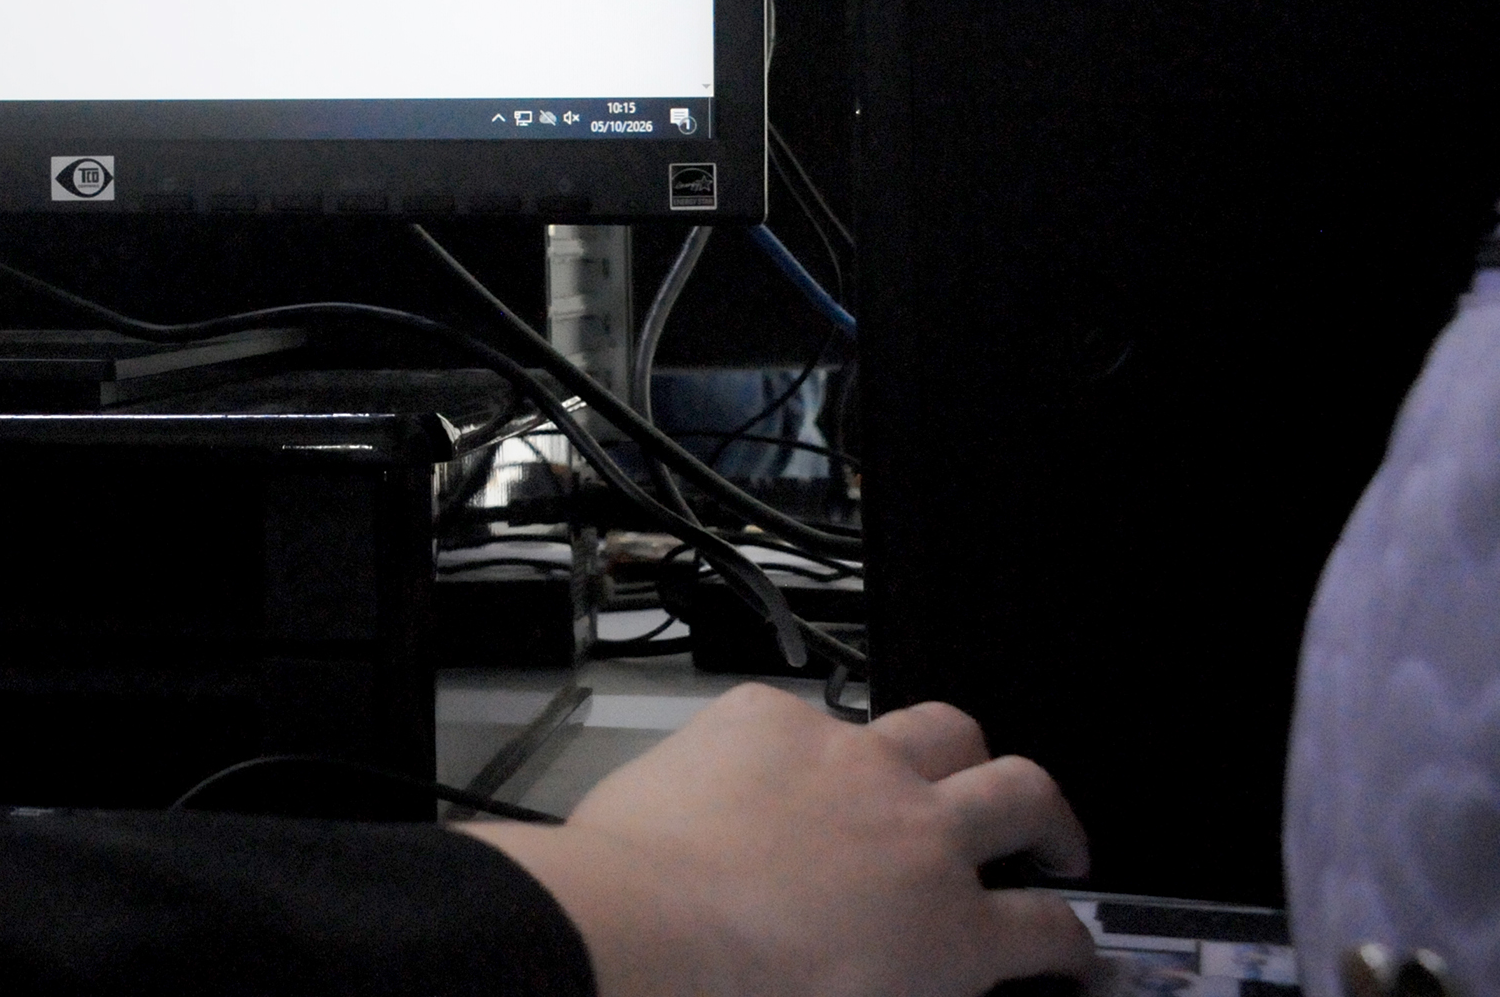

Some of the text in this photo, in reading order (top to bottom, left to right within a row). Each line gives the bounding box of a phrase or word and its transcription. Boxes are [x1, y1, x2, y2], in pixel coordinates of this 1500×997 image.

[607, 102, 636, 114] 10:15
[590, 121, 653, 133] 05/10/2026
[77, 167, 100, 184] TCO
